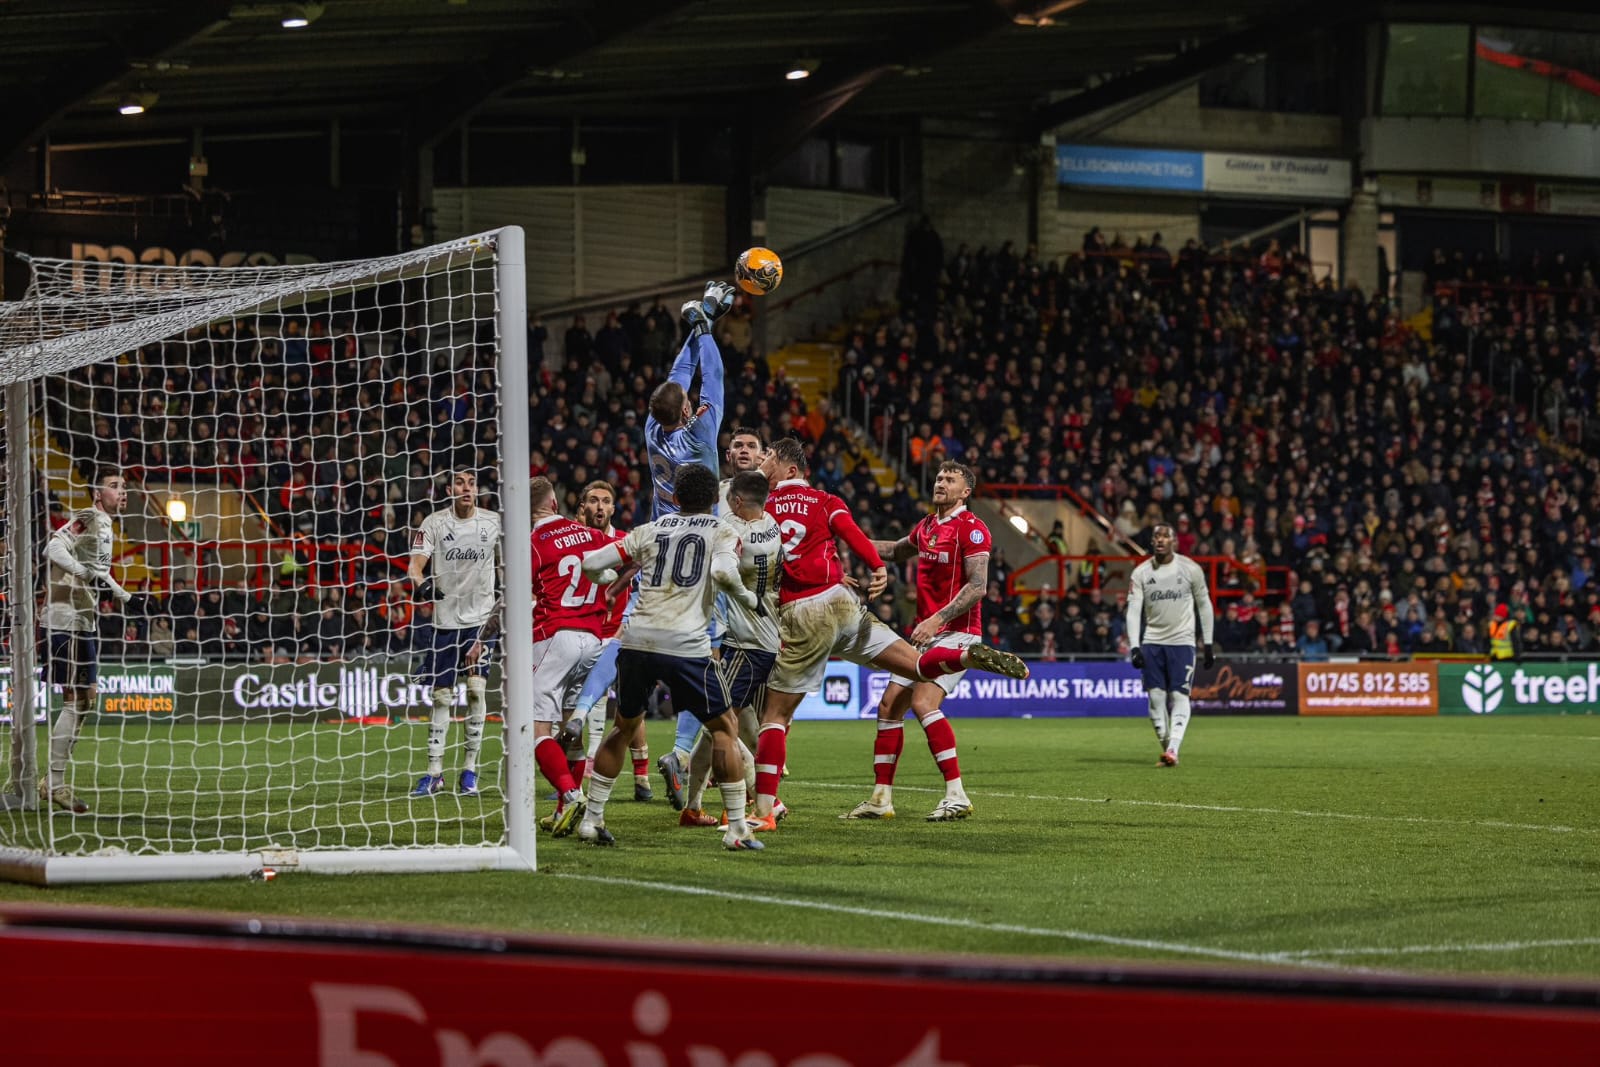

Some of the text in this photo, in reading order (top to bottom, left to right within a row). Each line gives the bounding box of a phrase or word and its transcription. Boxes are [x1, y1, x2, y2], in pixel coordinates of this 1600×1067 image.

[796, 493, 819, 504] Quest
[776, 502, 809, 516] DOYLE
[553, 530, 593, 549] O'BRIEN
[780, 519, 807, 562] 2
[445, 547, 486, 562] Bally's
[651, 533, 706, 587] 10
[233, 673, 338, 707] Castle
[974, 678, 1070, 699] WILLIAMS
[1071, 678, 1149, 699] TRAILER
[1306, 672, 1431, 692] 01745 812 585
[105, 694, 173, 712] architects
